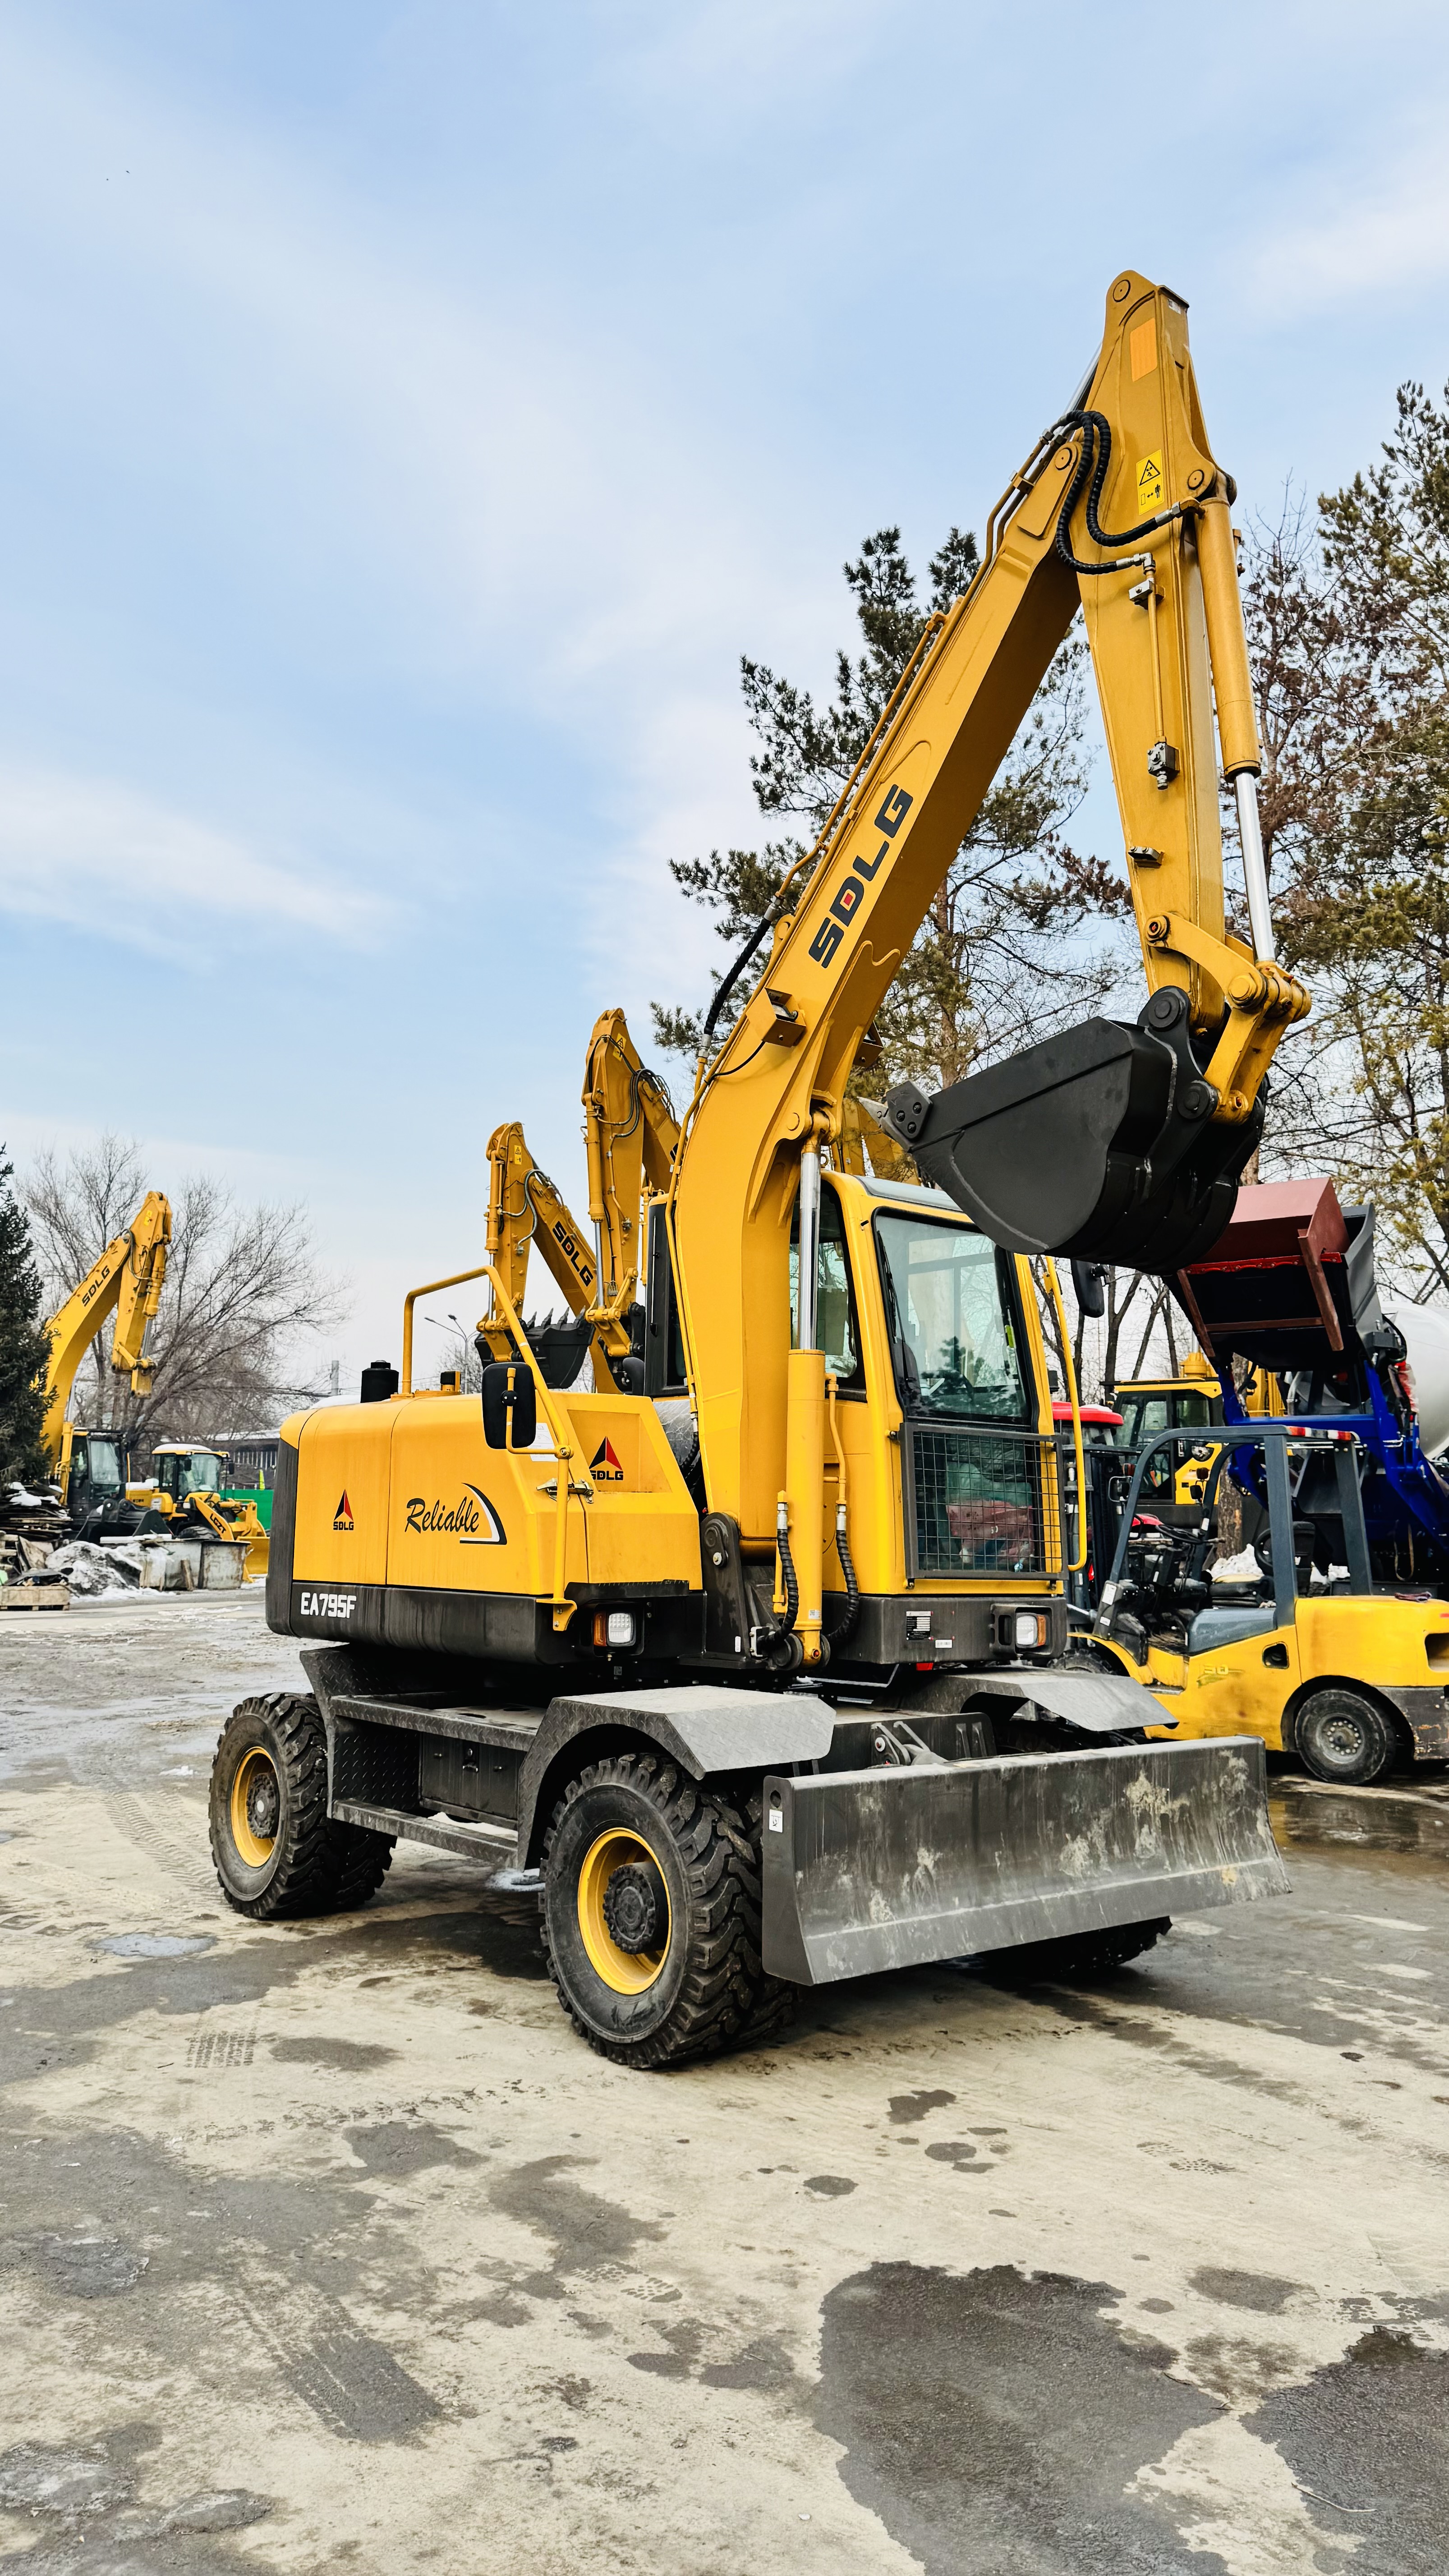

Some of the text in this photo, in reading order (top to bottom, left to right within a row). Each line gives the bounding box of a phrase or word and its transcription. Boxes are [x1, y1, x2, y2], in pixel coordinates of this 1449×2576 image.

[808, 784, 913, 969] SDLG
[552, 1221, 593, 1287] SDLG
[82, 1265, 110, 1307] SDLG
[333, 1522, 354, 1530] SDLG
[405, 1496, 479, 1533] Reliable
[301, 1592, 357, 1619] EA795F
